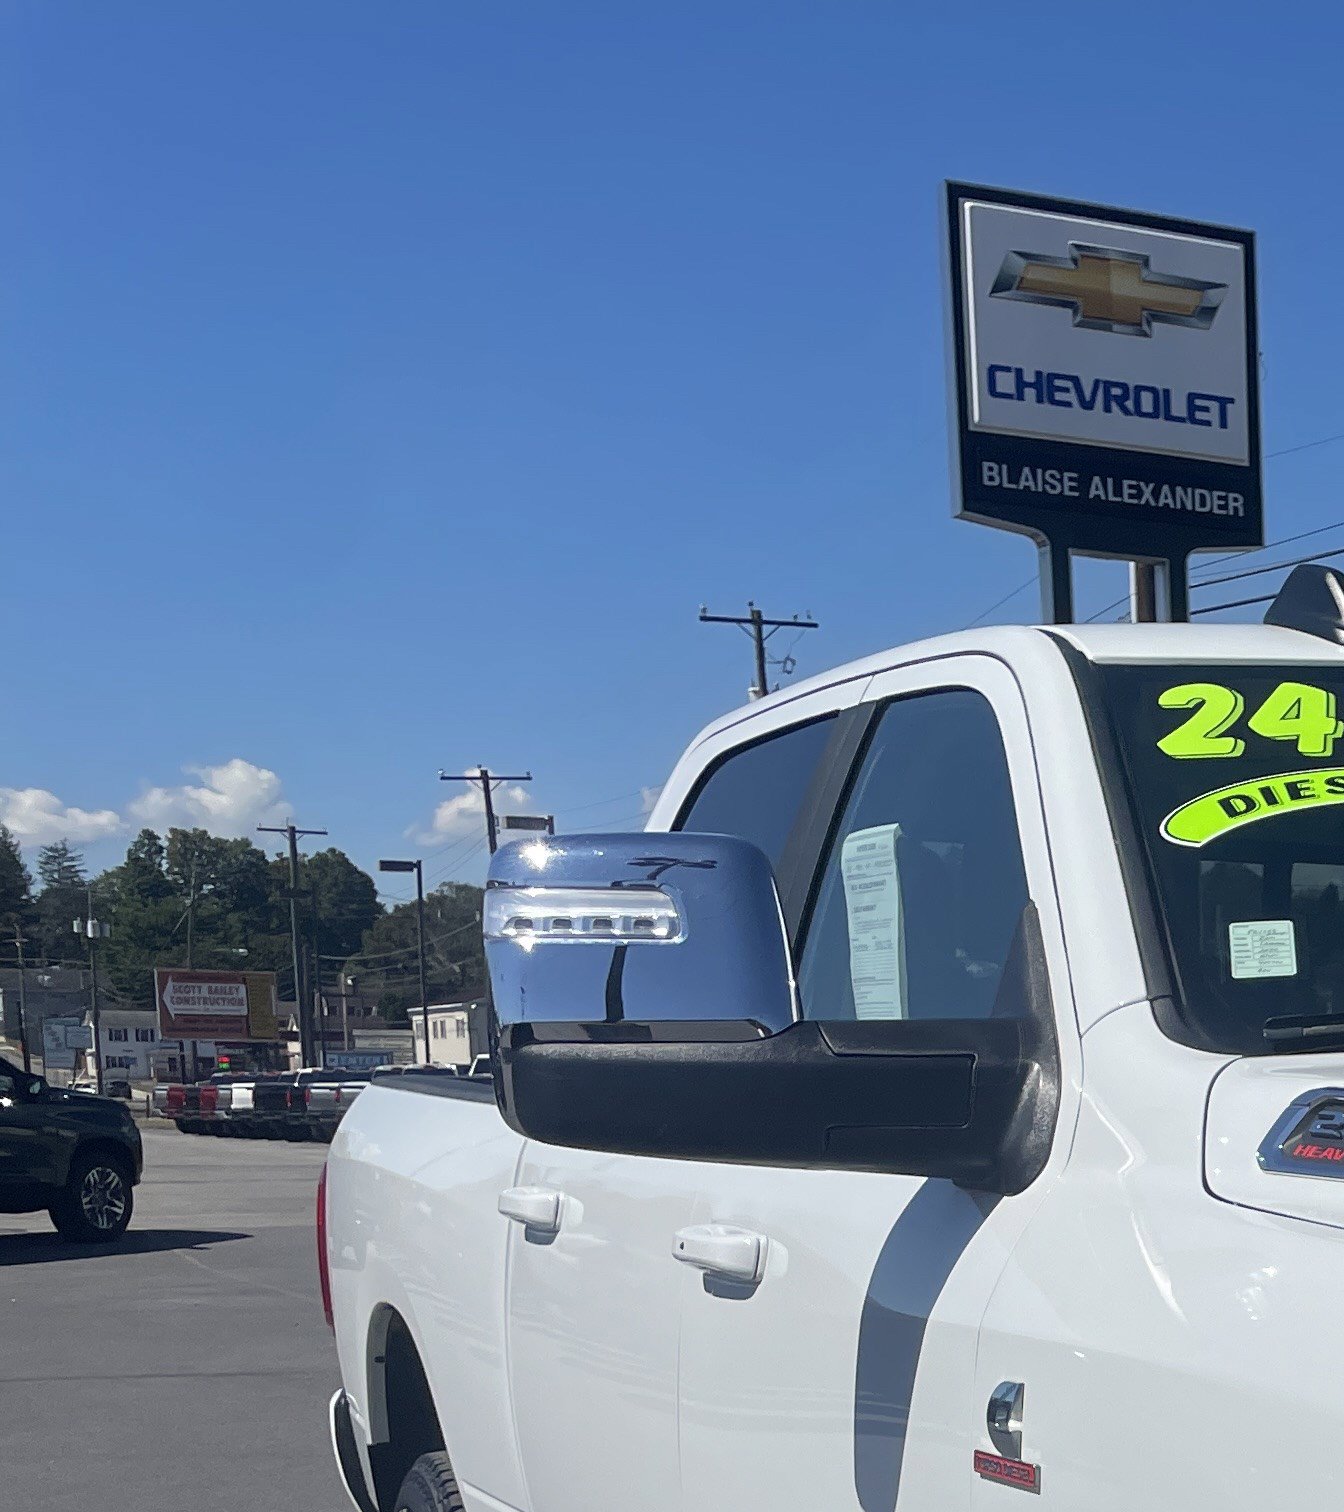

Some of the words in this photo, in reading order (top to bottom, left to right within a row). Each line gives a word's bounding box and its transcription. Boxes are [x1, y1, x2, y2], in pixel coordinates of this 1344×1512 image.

[986, 363, 1235, 430] CHEVROLET
[980, 461, 1080, 498] BLAISE
[1088, 475, 1245, 518] ALEXANDER
